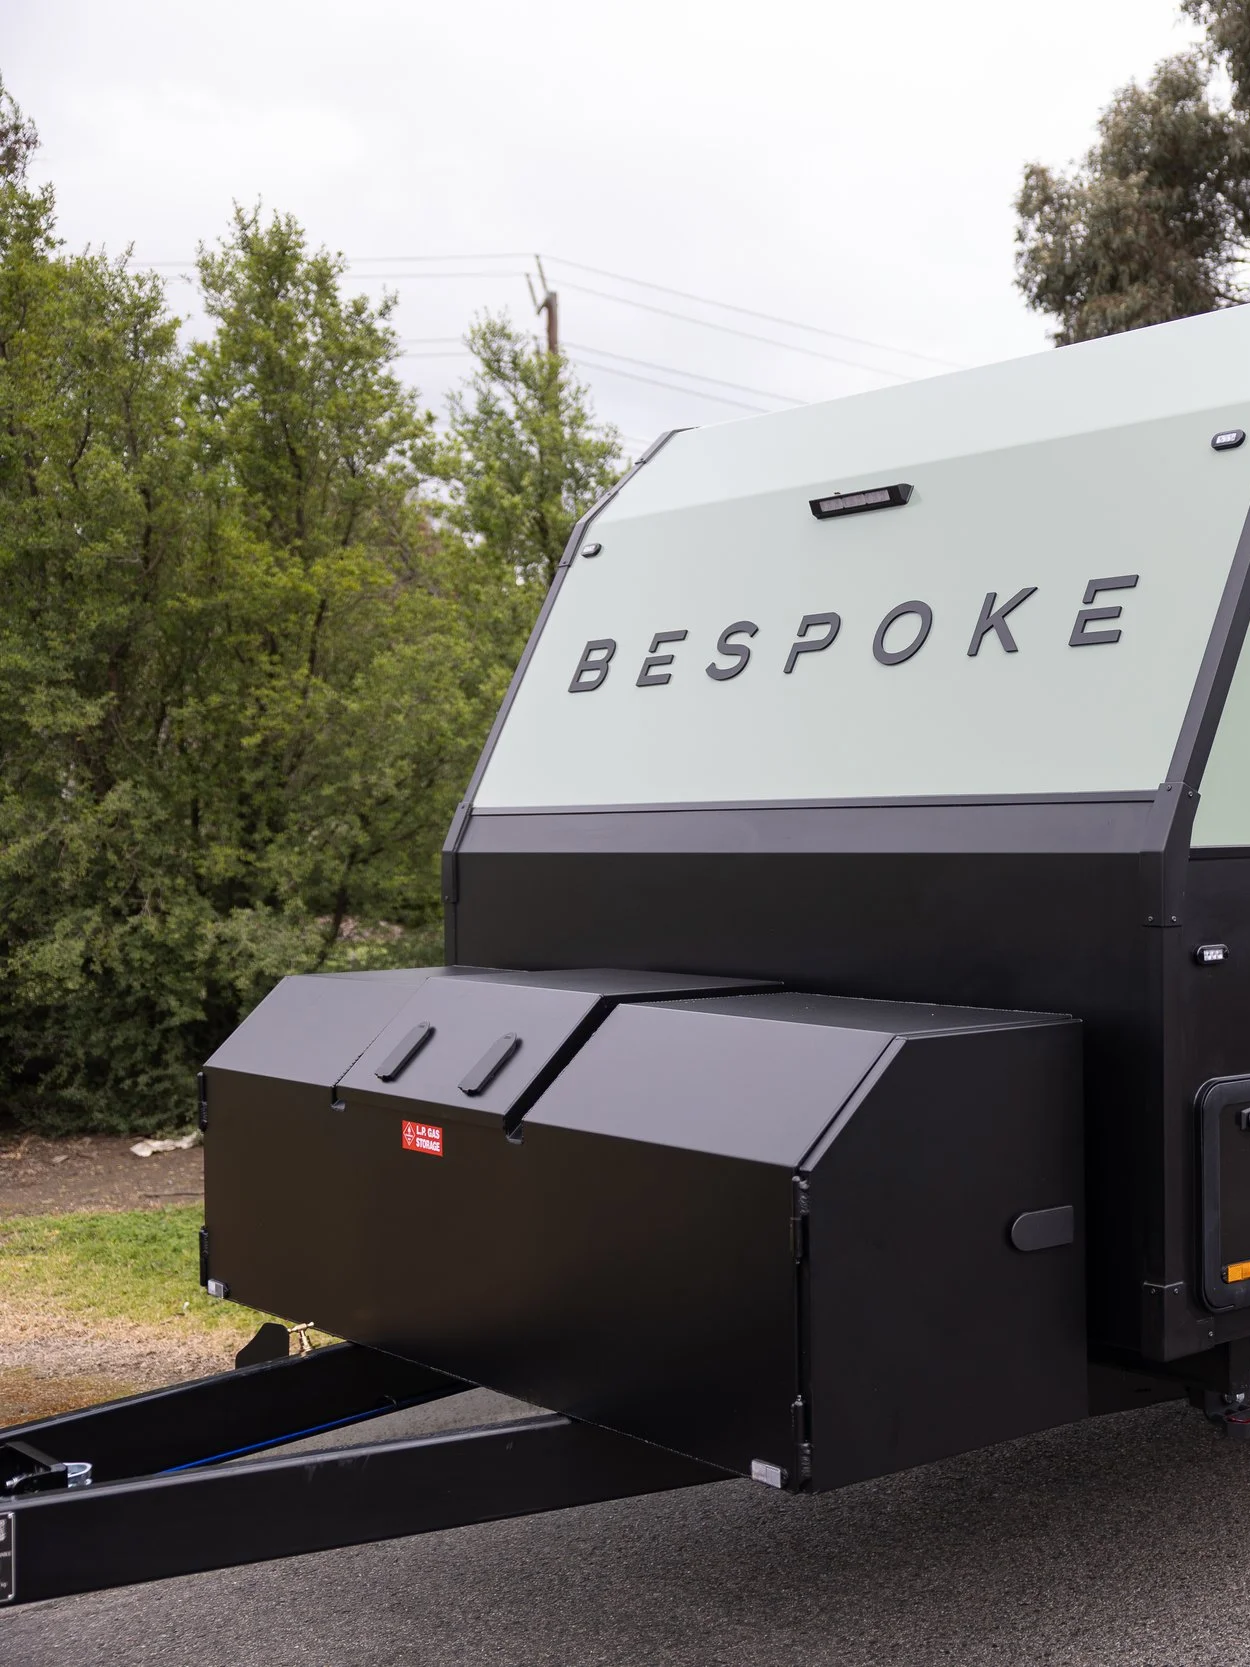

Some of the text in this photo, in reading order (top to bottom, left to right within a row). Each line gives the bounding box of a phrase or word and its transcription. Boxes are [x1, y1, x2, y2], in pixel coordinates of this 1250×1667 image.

[568, 574, 1139, 693] BESPOKE
[427, 1128, 440, 1139] GAS
[415, 1137, 440, 1152] STORAGE
